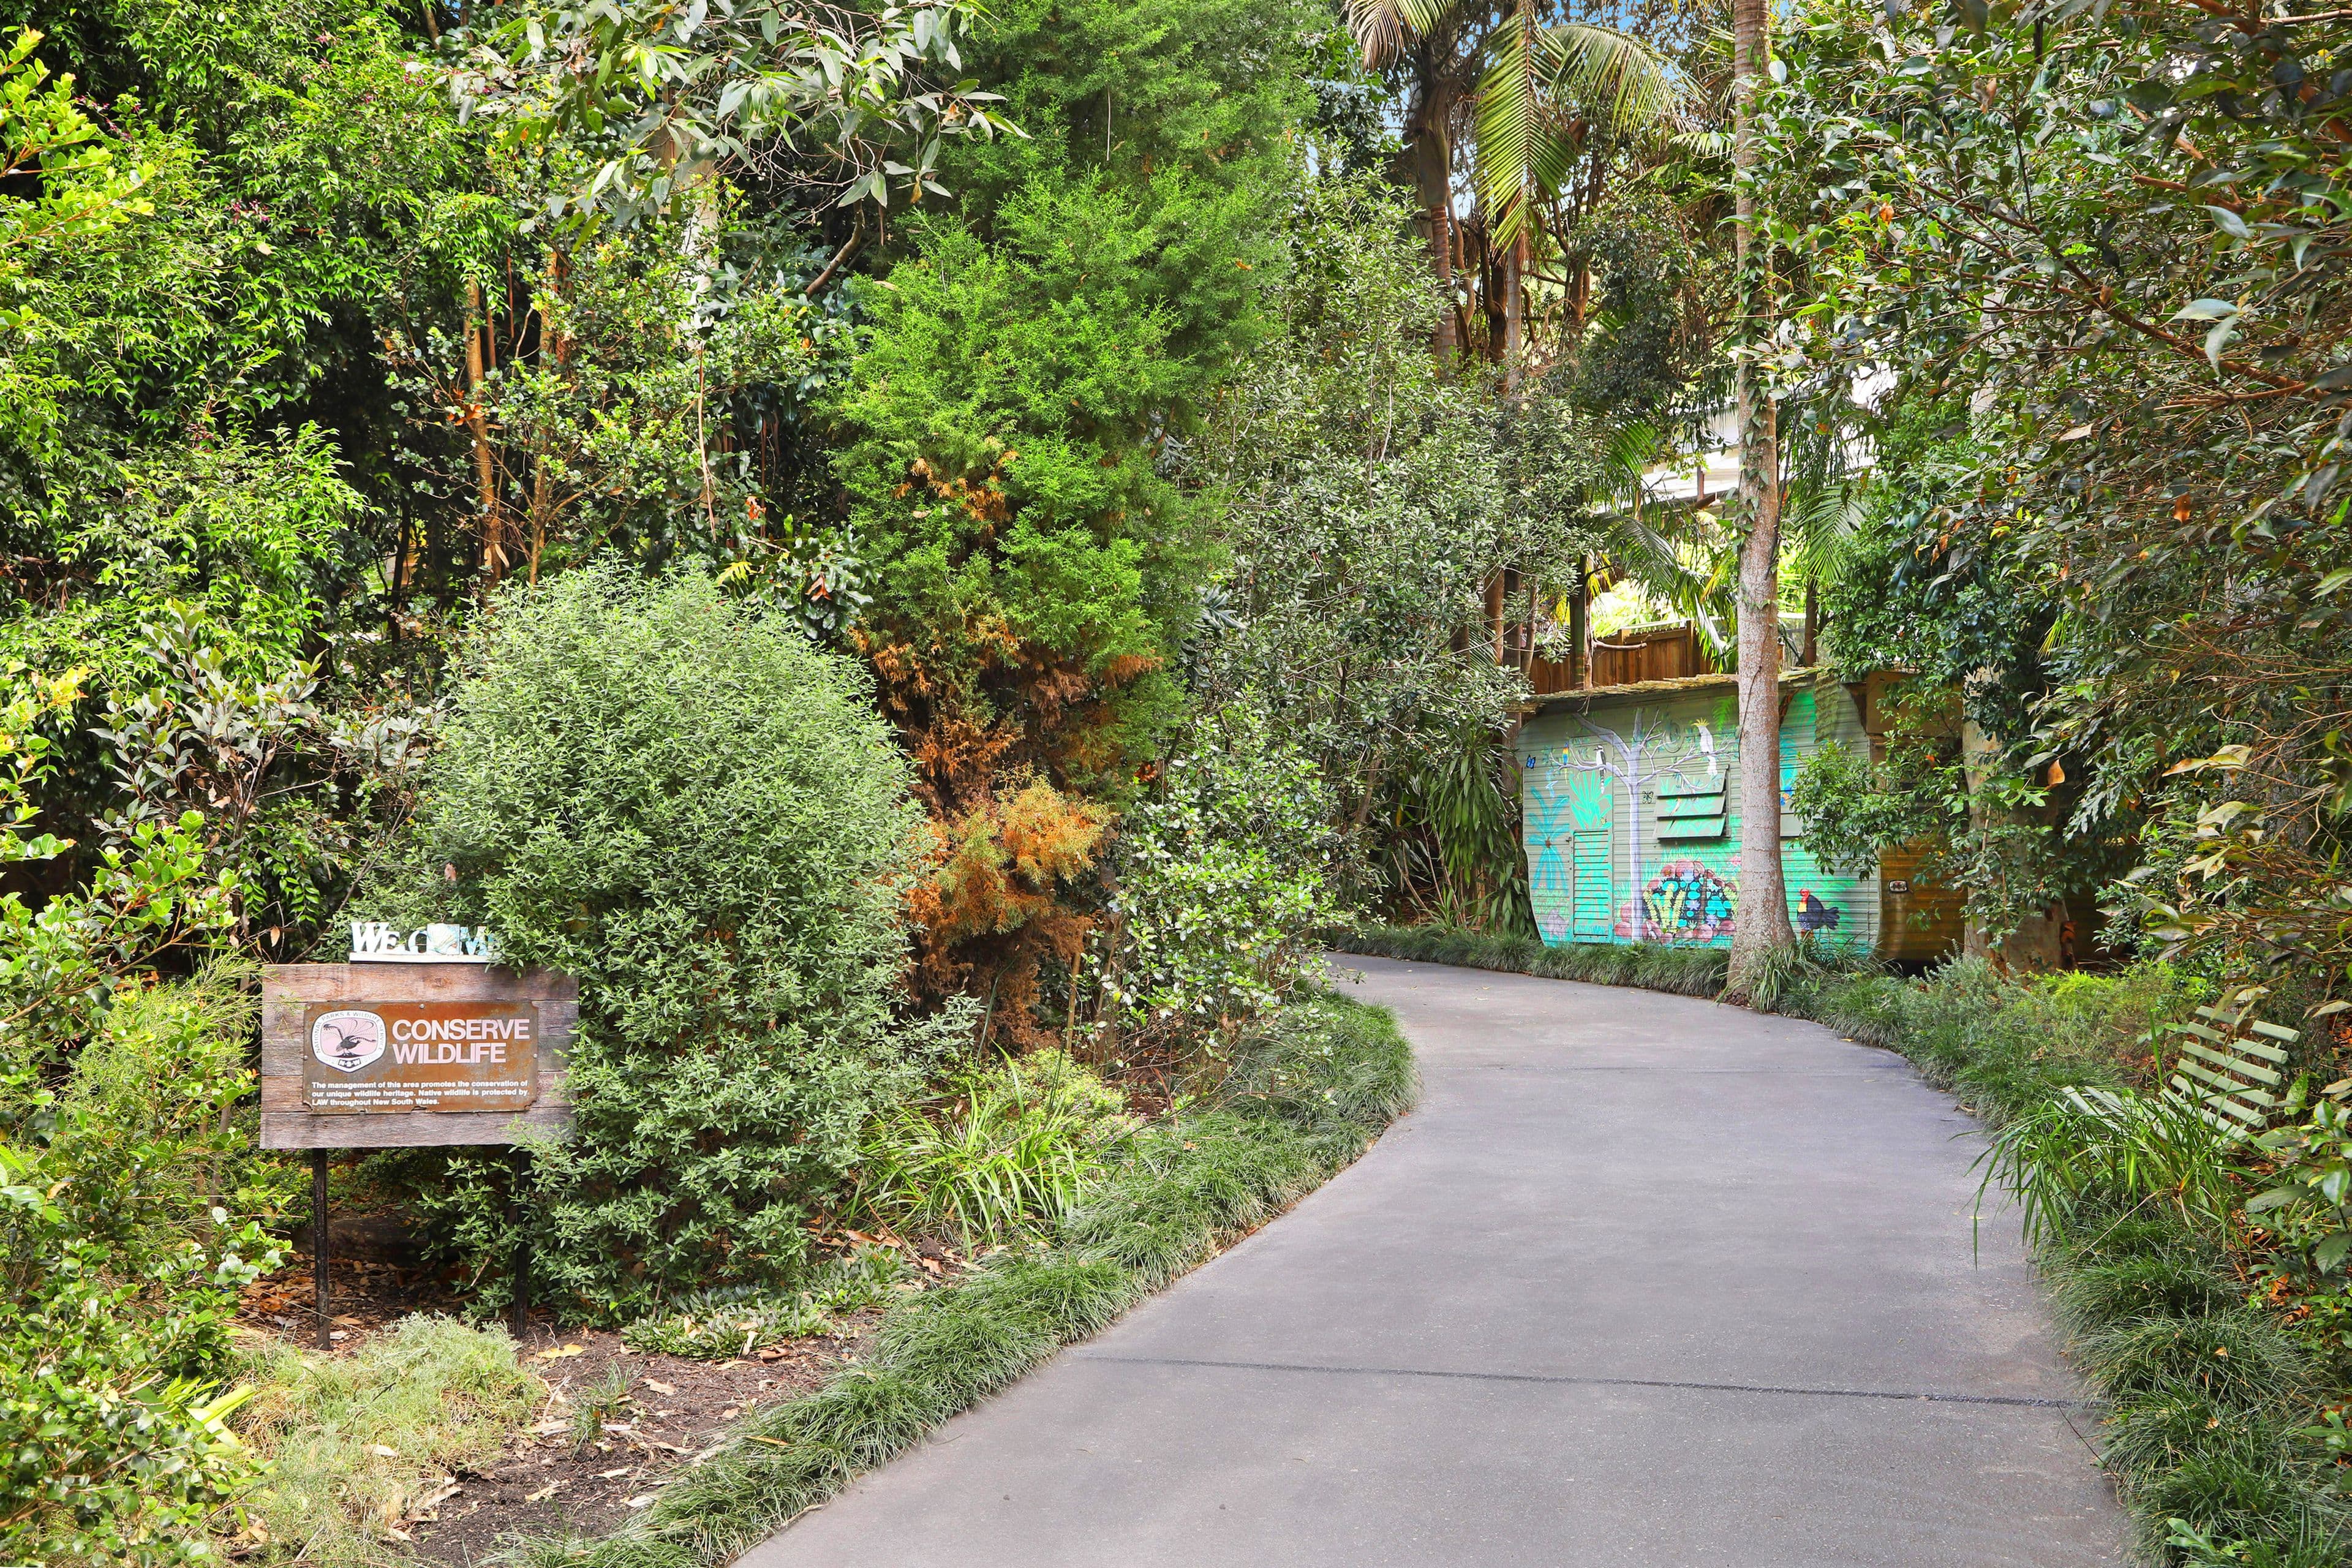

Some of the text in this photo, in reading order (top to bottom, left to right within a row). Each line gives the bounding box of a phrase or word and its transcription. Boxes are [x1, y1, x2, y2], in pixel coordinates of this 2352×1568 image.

[392, 1019, 530, 1041] CONSERVE
[392, 1042, 507, 1064] WILDLIFE
[481, 1088, 516, 1097] protected
